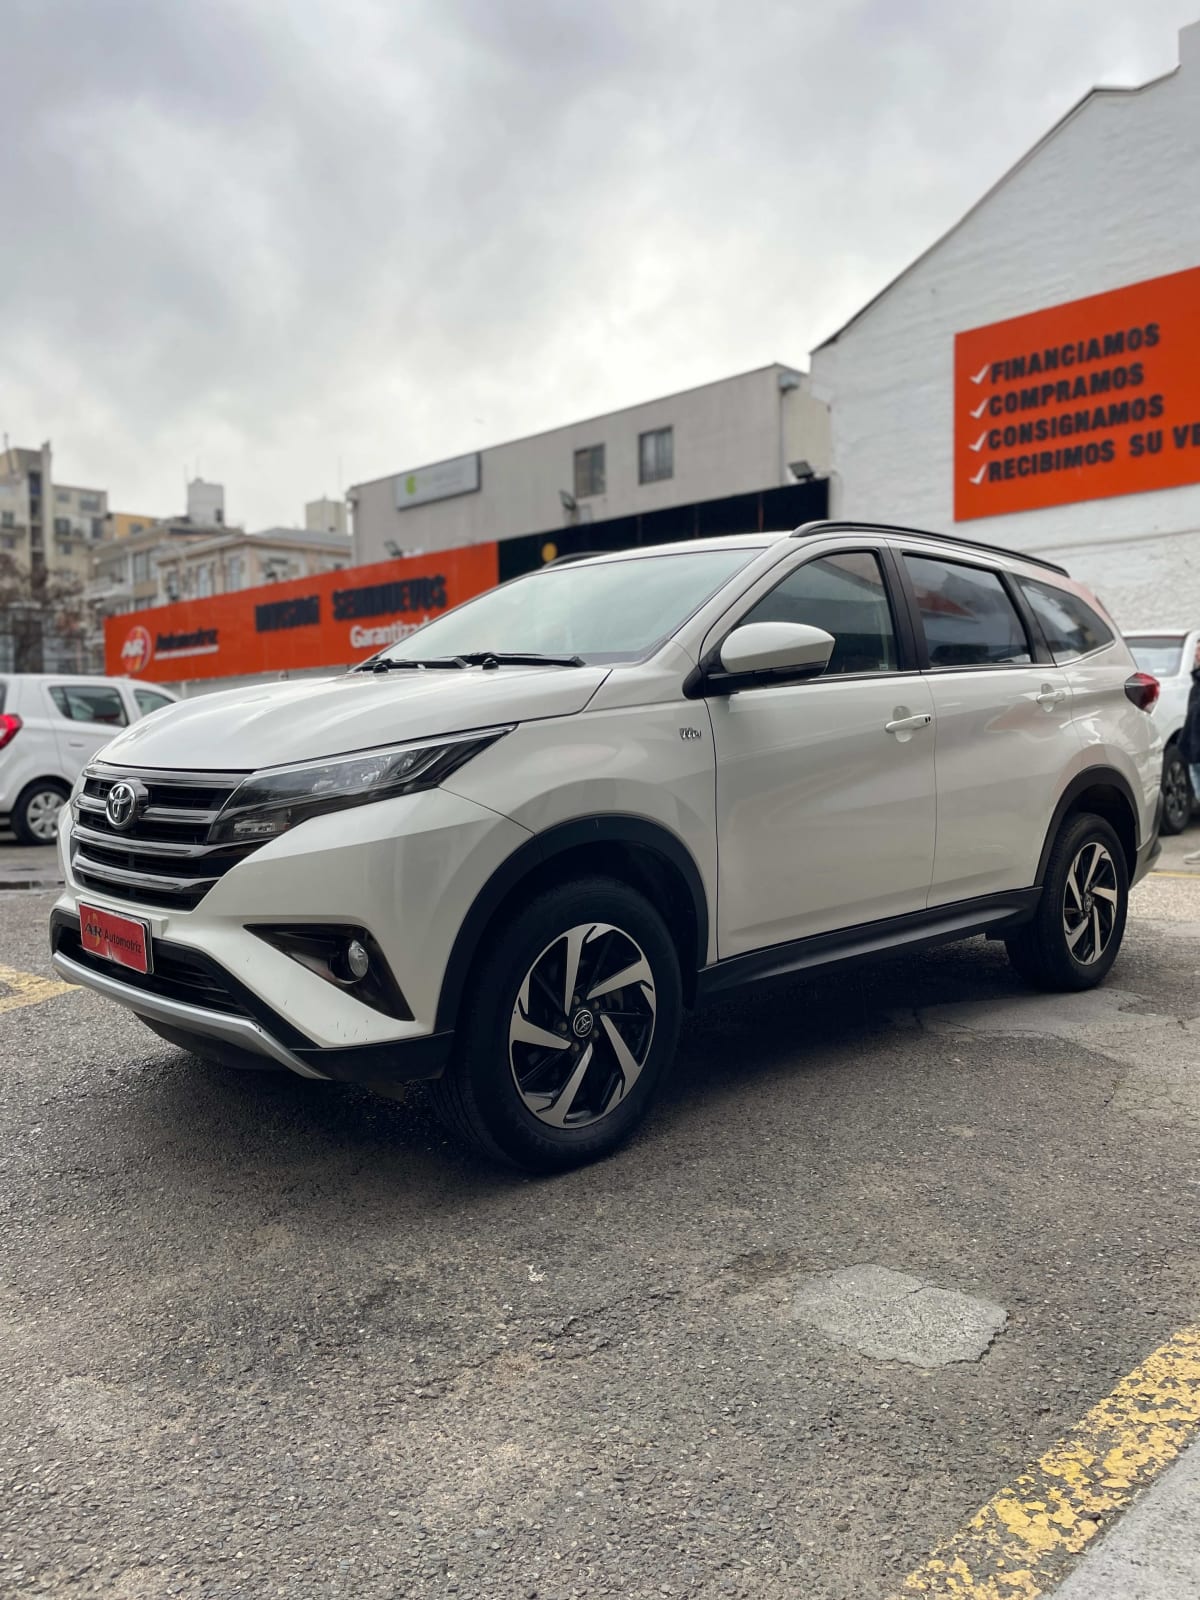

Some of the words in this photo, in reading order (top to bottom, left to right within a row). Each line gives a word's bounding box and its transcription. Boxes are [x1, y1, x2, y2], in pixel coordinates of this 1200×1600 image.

[990, 322, 1160, 384] FINANCIAMOS
[988, 362, 1145, 417] COMPRAMOS
[987, 394, 1164, 450] CONSIGNAMOS
[988, 440, 1115, 483] RECIBIMOS
[1129, 429, 1163, 457] SU
[104, 929, 142, 954] Automotriz
